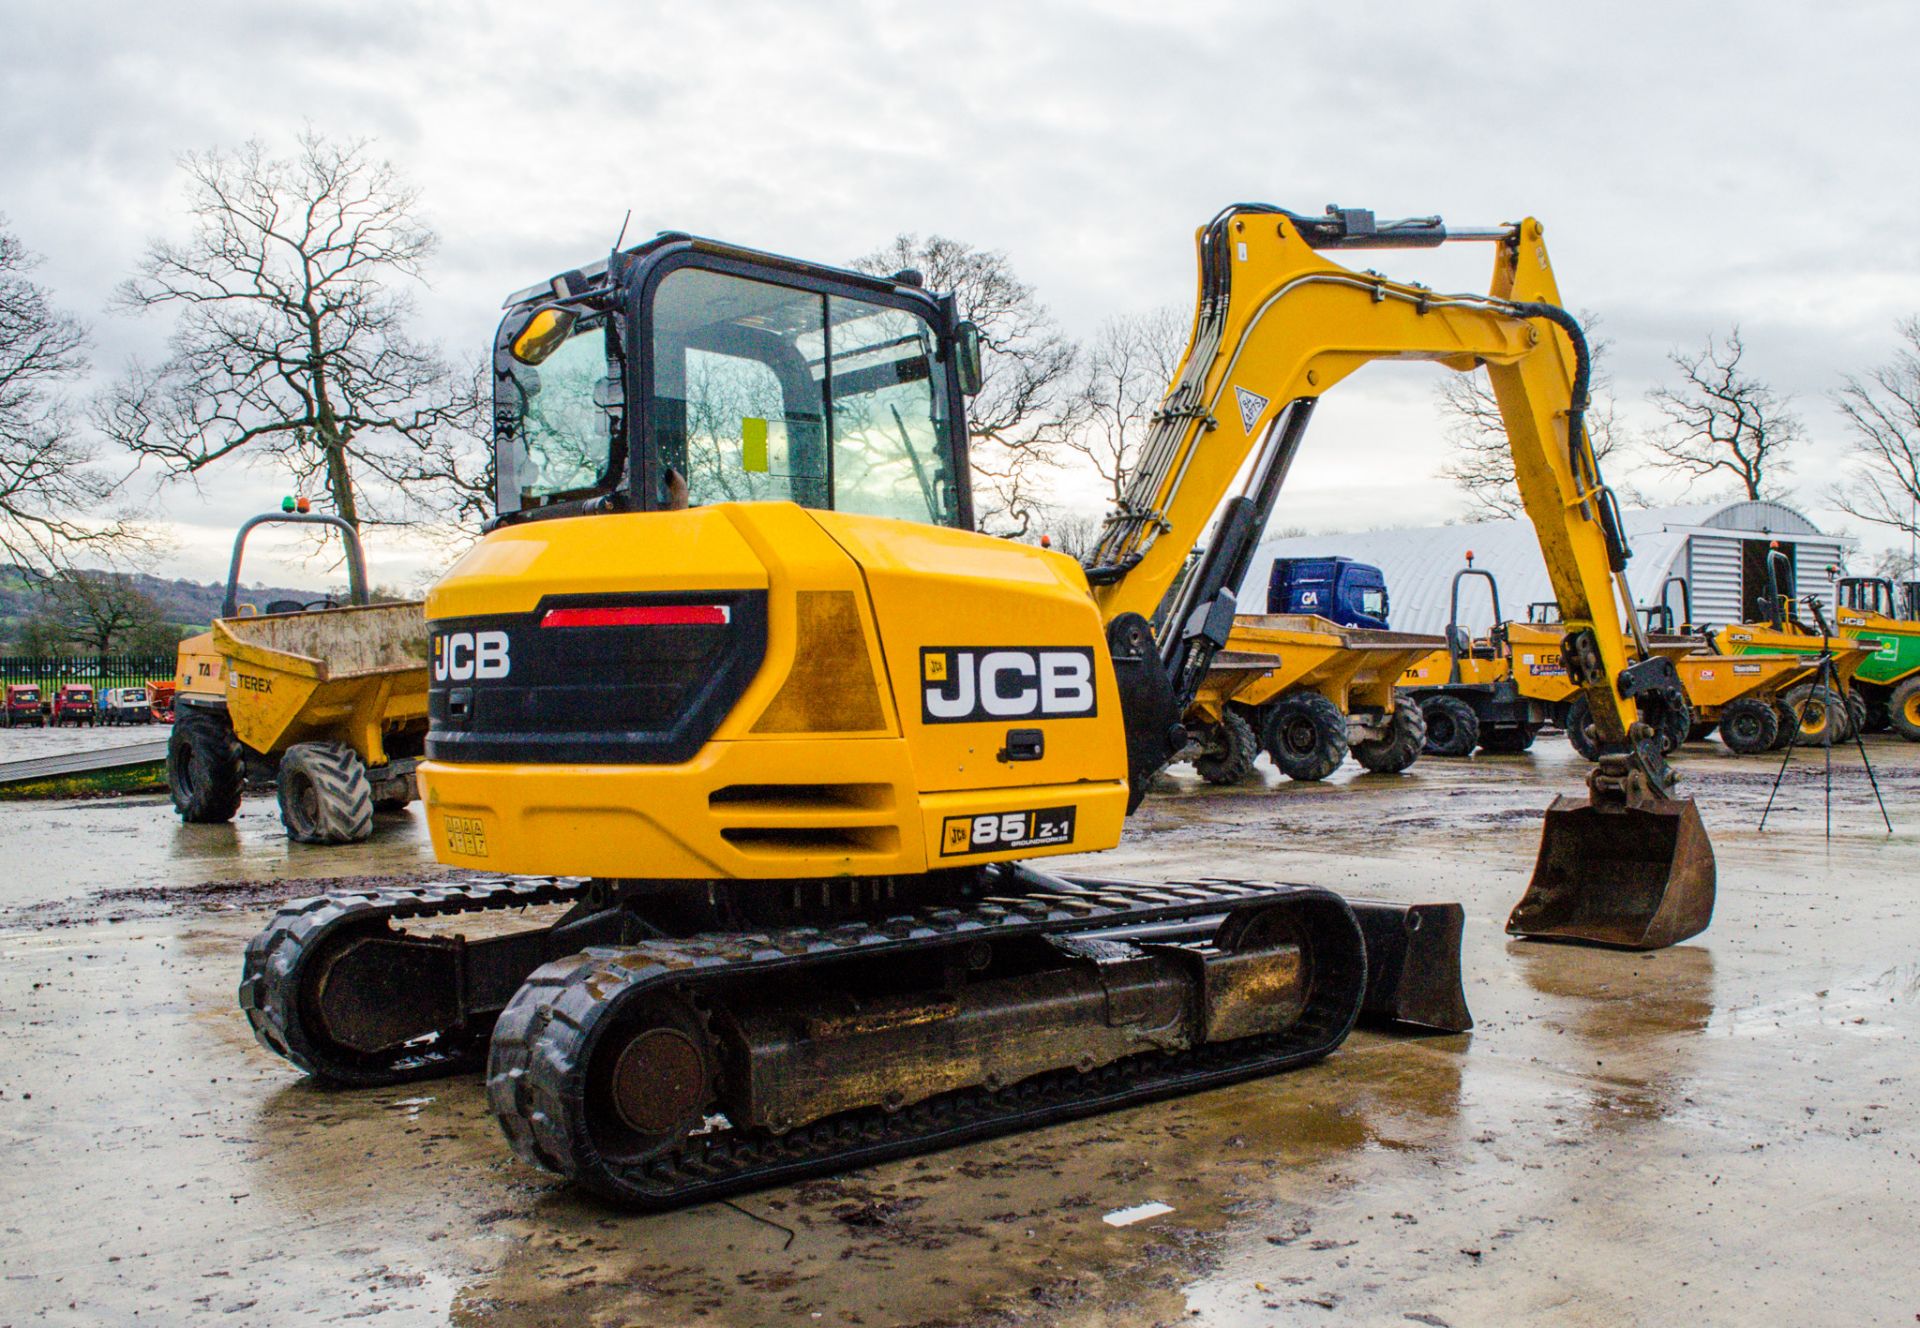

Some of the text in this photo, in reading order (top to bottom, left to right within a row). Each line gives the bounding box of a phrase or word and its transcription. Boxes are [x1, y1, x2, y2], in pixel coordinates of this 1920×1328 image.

[1840, 617, 1866, 626] JCB
[435, 630, 511, 681] JCB
[238, 673, 273, 694] TEREX
[926, 651, 1094, 718] JCB
[972, 813, 1026, 845] 85
[1011, 835, 1069, 847] GROUNDWORKER
